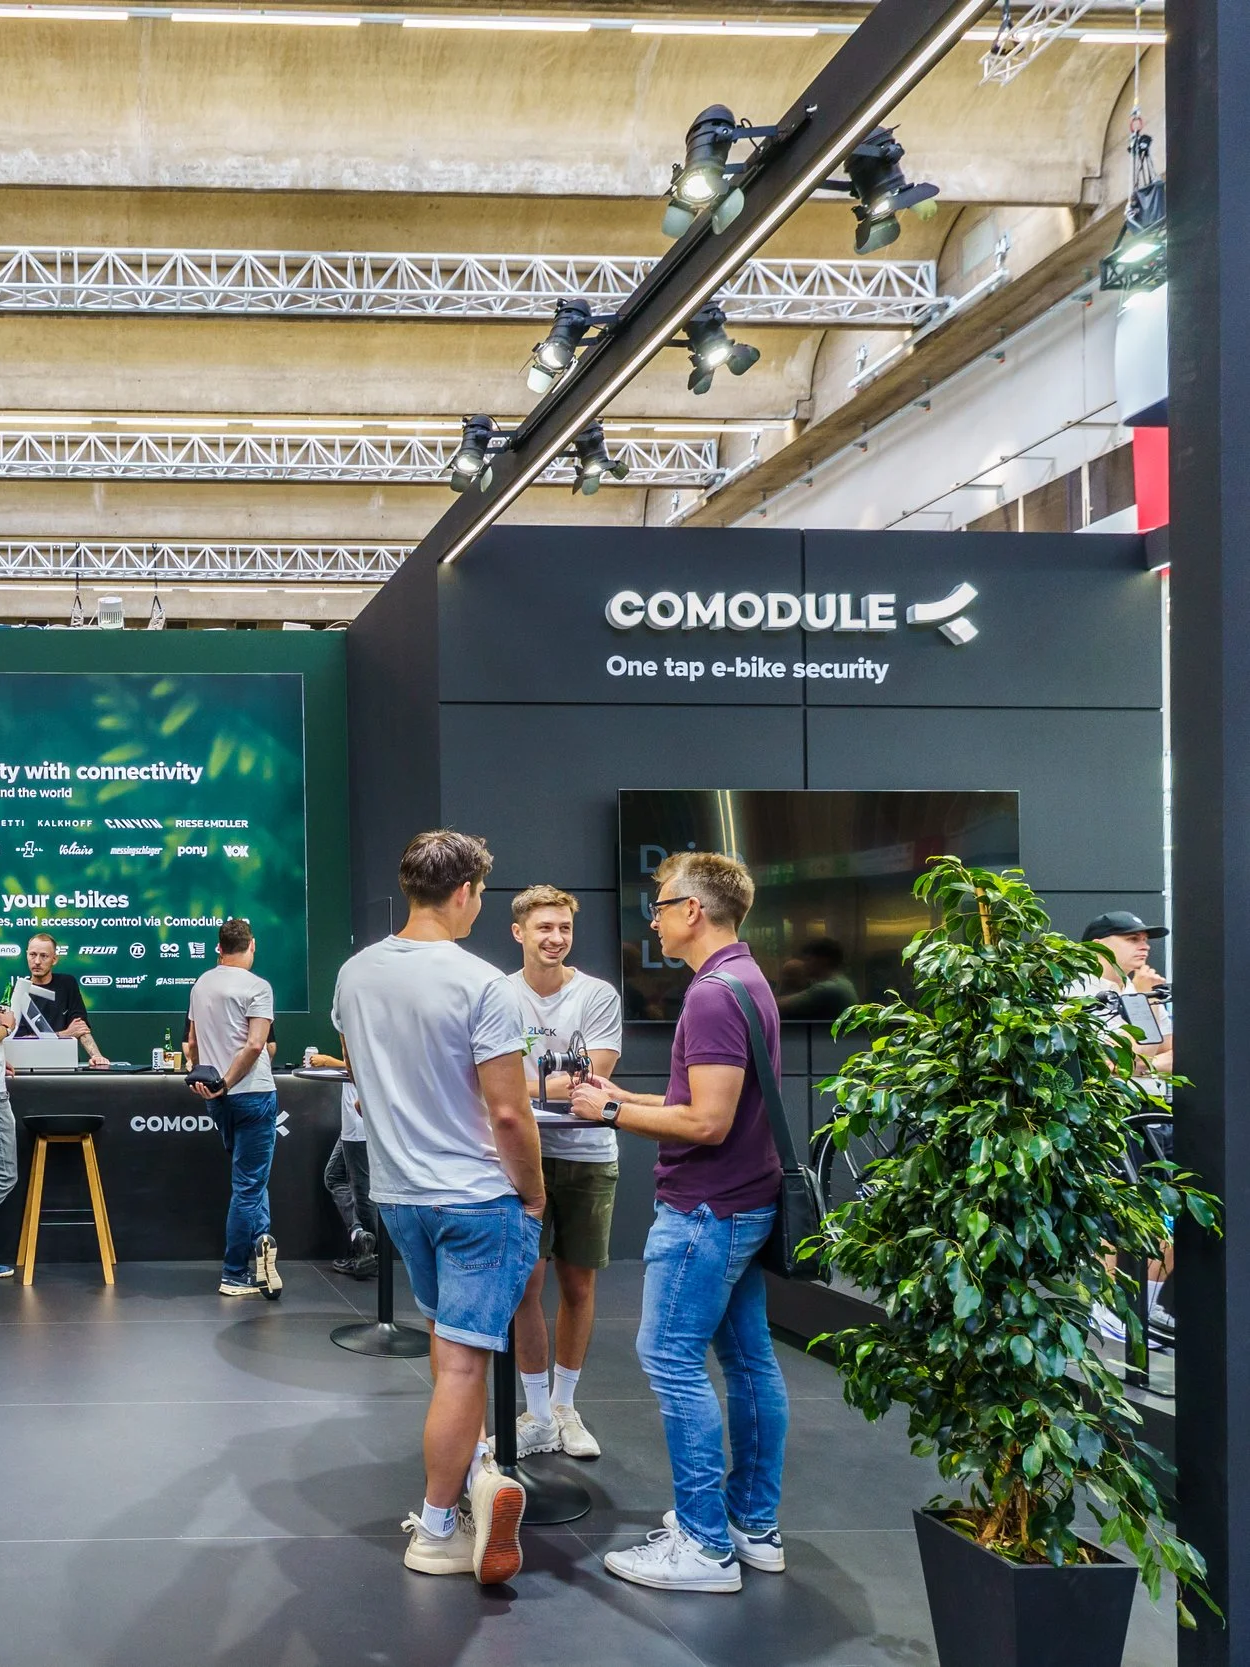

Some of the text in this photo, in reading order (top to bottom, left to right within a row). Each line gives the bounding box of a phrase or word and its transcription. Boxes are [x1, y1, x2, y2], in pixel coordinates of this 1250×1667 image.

[605, 590, 897, 632] COMODULE
[606, 656, 889, 684] One tap e-bike security
[24, 761, 70, 780] with
[76, 761, 203, 784] connectivity
[18, 787, 37, 798] the
[40, 788, 72, 798] world
[104, 818, 163, 829] CANYON
[59, 841, 94, 856] Voltaire
[177, 846, 208, 857] pony
[222, 845, 249, 857] VOK
[1, 893, 49, 912] your
[54, 890, 129, 909] e-bikes
[16, 916, 38, 927] and
[41, 918, 98, 929] accessory
[101, 916, 141, 927] control
[144, 916, 161, 927] via
[164, 916, 223, 927] Comodule
[78, 946, 118, 955] FAZUA
[130, 1115, 219, 1132] COMOD
